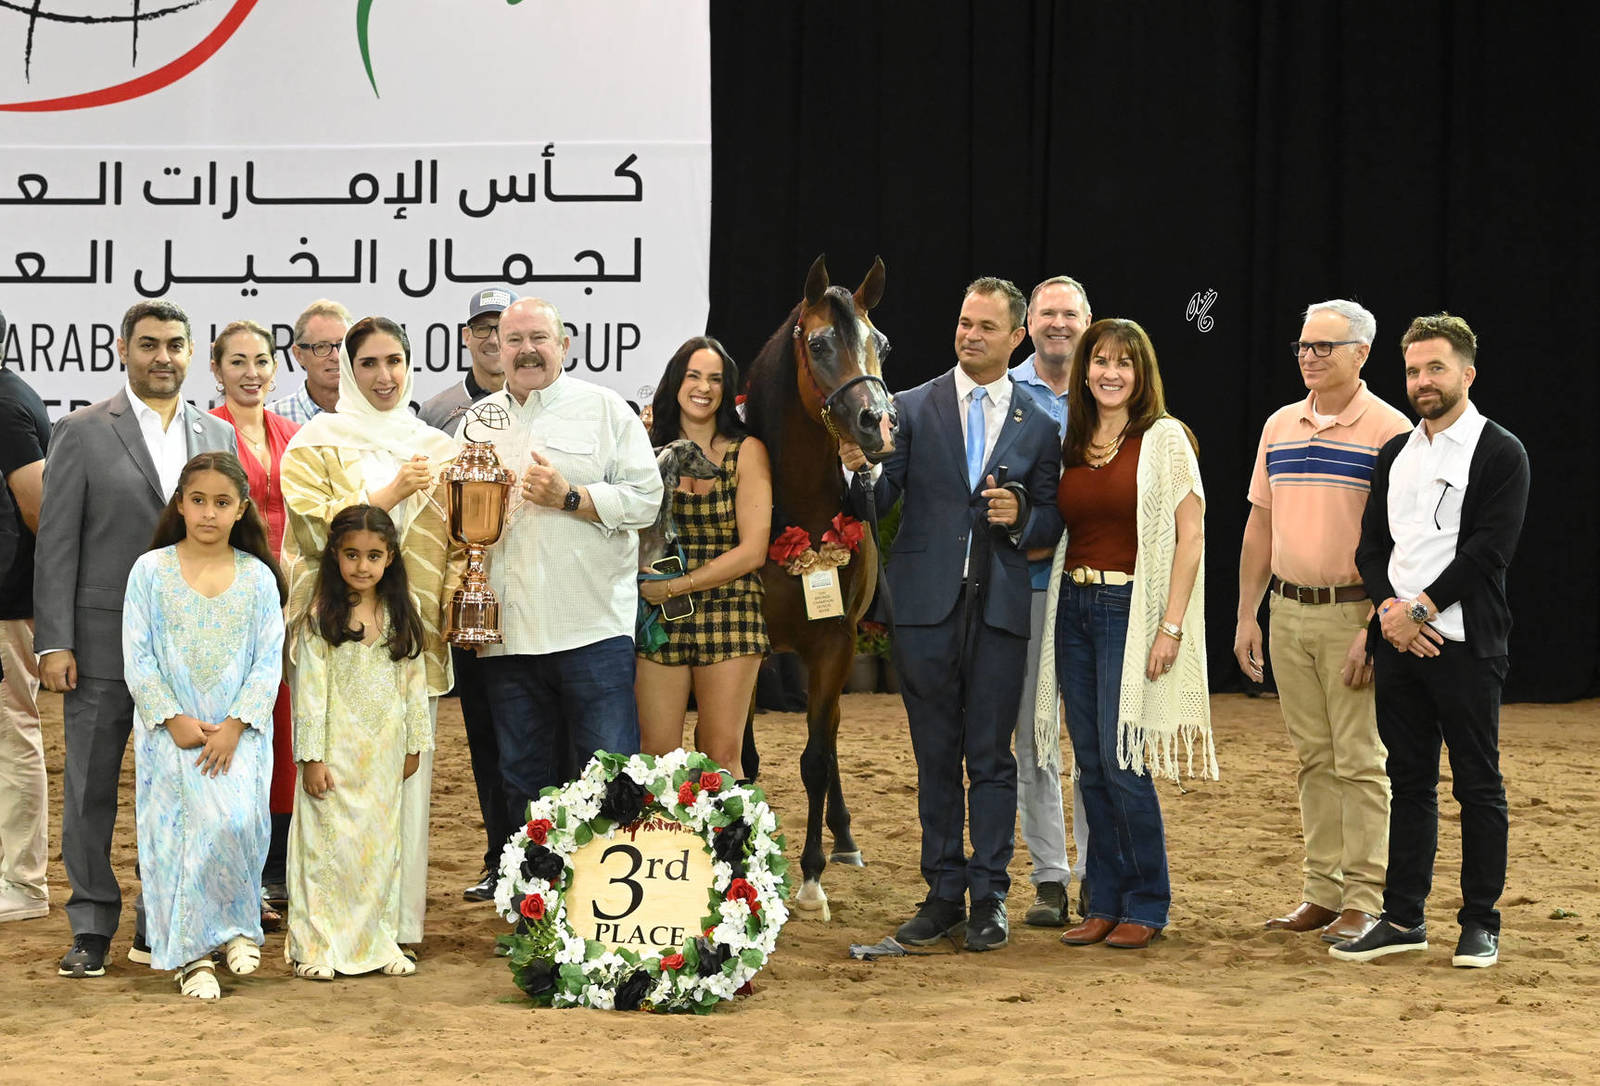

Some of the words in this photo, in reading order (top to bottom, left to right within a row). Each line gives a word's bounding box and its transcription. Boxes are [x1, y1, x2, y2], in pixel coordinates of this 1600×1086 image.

[142, 159, 438, 220] الإمارات
[458, 144, 643, 218] كأس
[133, 236, 377, 299] الخيل
[398, 237, 642, 299] لجمال
[1, 323, 125, 372] ARAB
[591, 844, 690, 921] 3rd
[595, 922, 685, 947] PLACE
